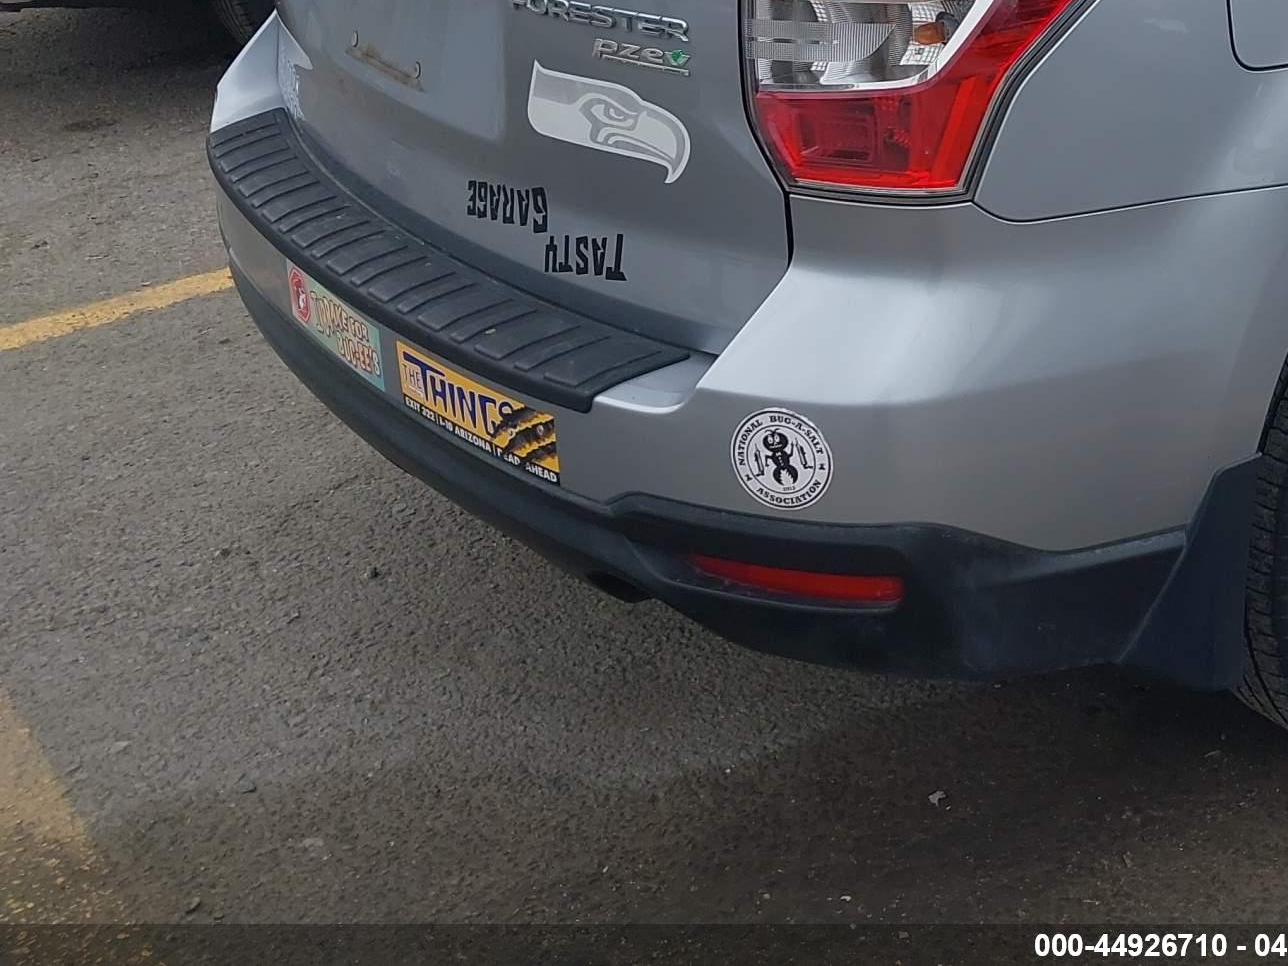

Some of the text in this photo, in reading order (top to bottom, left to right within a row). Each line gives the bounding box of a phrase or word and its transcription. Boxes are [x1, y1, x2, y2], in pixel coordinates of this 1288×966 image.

[467, 180, 548, 234] GARAGE
[544, 234, 627, 281] TASTY
[348, 316, 369, 343] FOR
[402, 363, 424, 390] THE
[405, 396, 421, 413] EXIT
[454, 425, 491, 453] ARIZONA
[525, 461, 558, 483] AHEAD
[737, 415, 824, 466] NATIONAL BUG-A-SALT
[756, 479, 822, 505] ASSOCIATION
